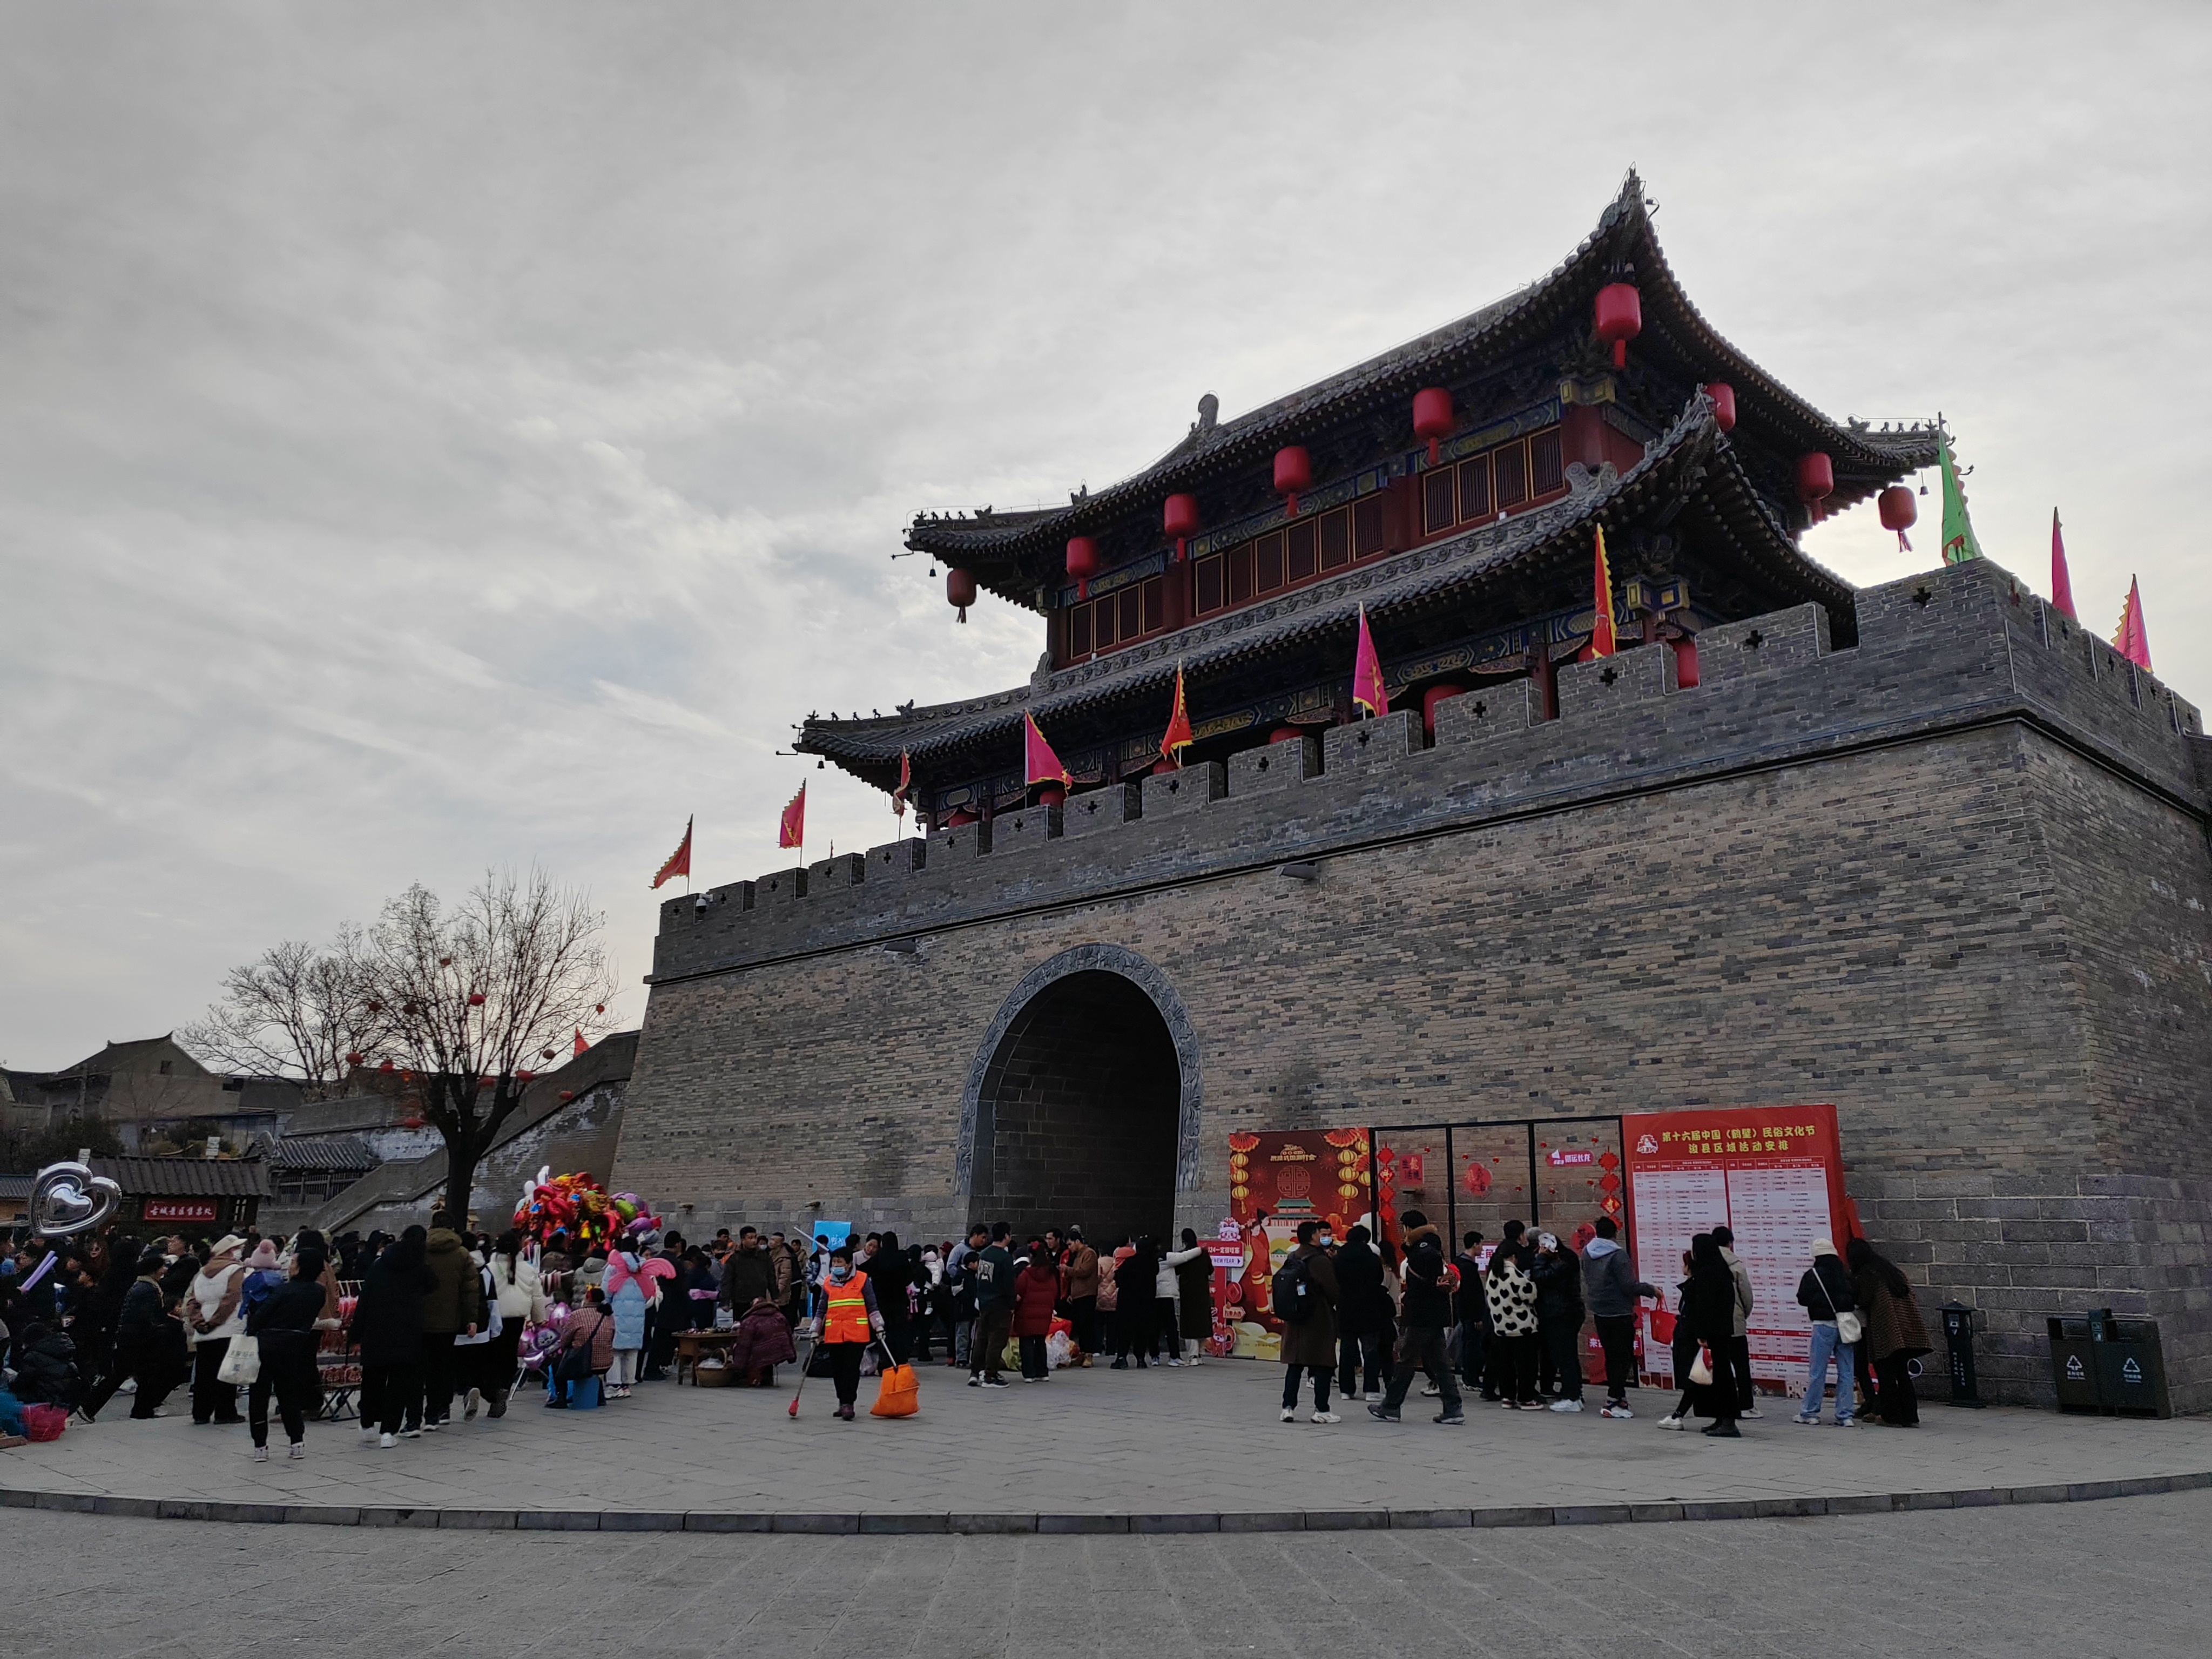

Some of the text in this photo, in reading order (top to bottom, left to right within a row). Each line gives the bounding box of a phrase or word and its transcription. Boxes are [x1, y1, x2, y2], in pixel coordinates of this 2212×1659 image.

[1689, 1140, 1789, 1154] 浚县区域活动安排
[150, 1205, 212, 1216] 古城景区售票处
